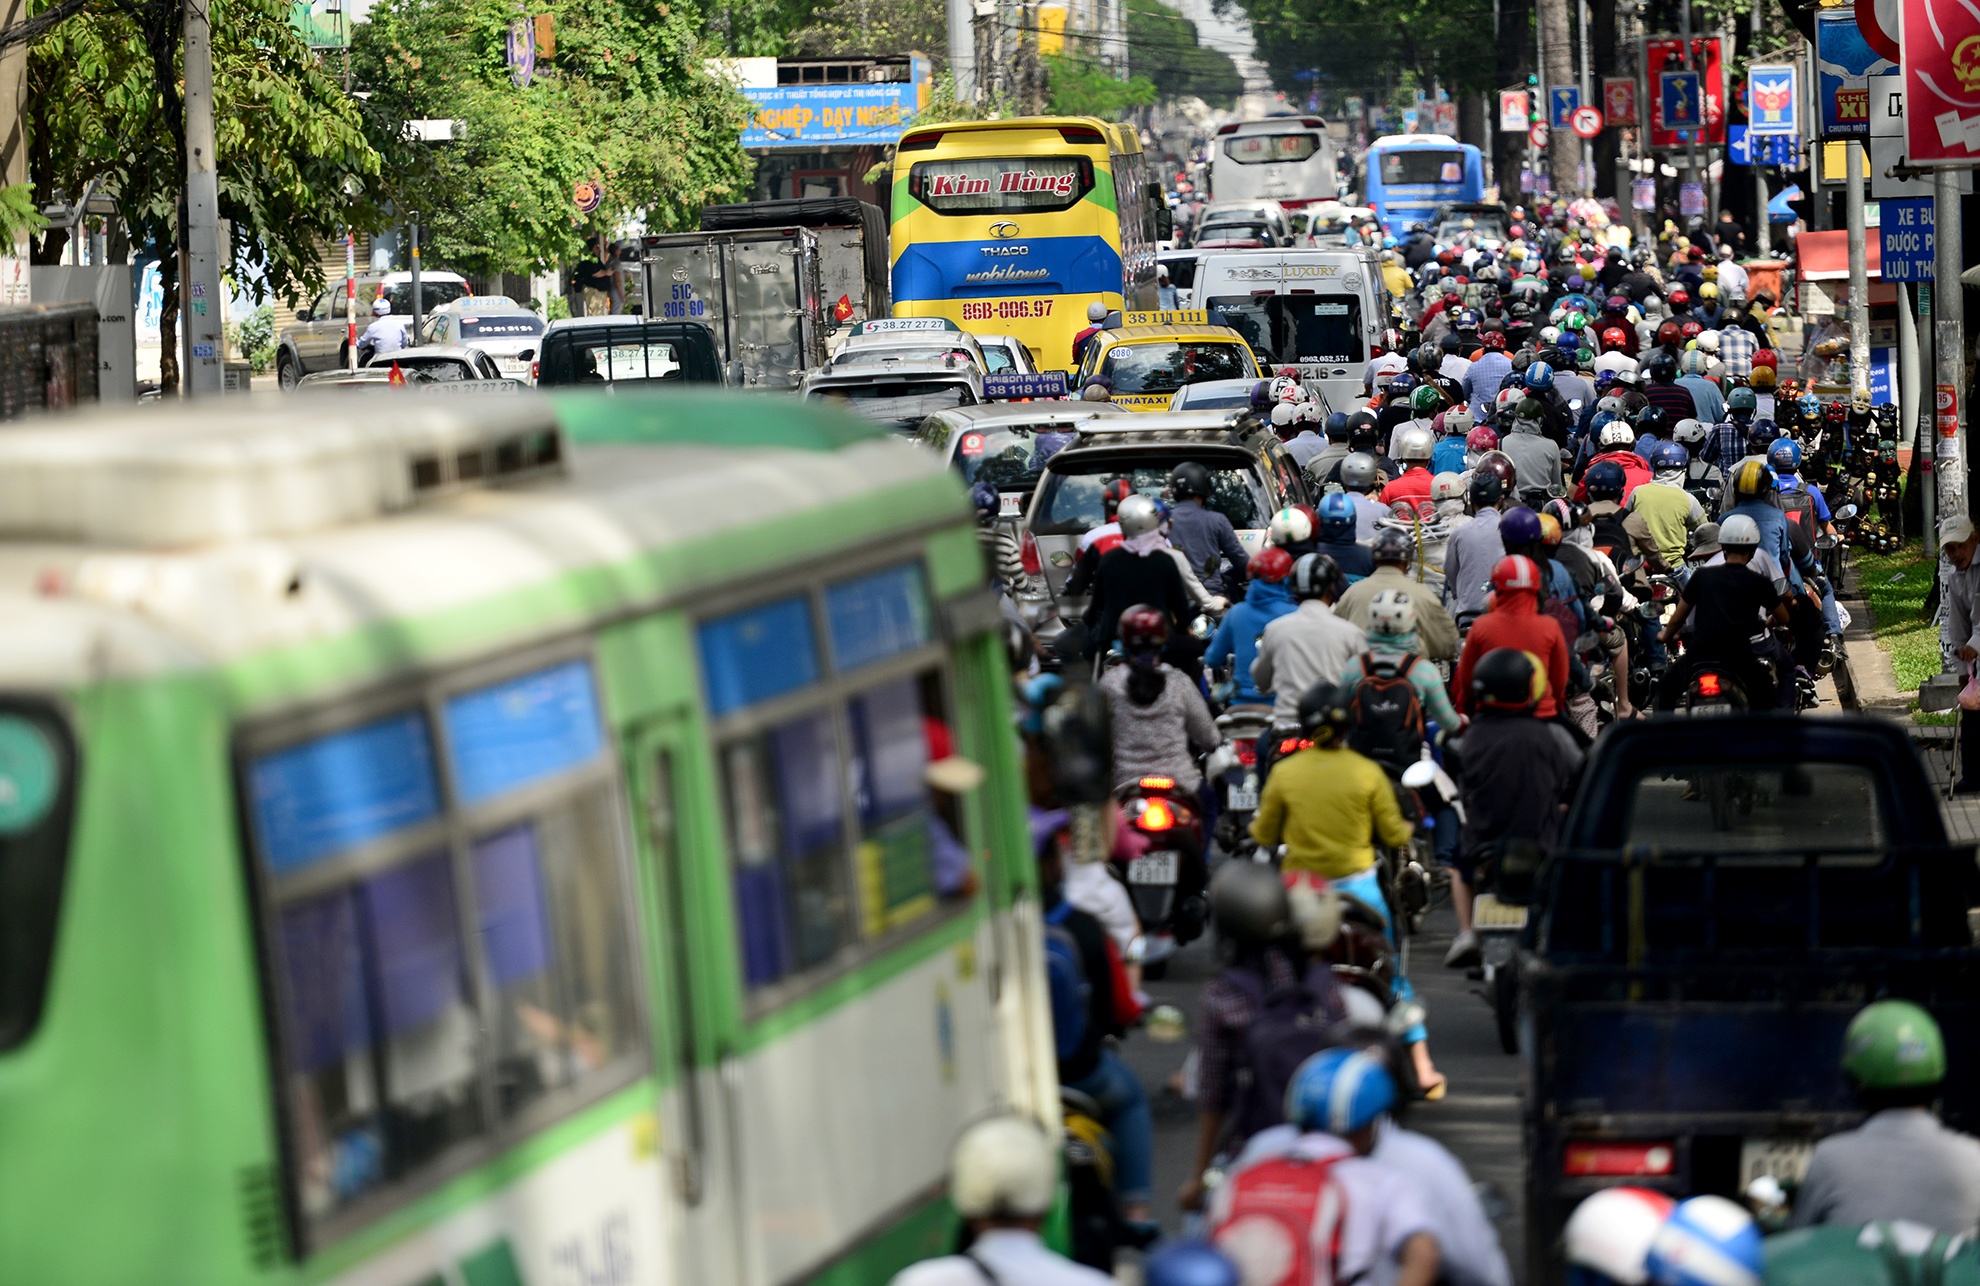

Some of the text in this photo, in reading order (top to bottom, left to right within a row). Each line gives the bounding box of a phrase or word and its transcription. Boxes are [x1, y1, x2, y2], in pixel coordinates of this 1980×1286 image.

[822, 106, 854, 134] DẠY
[1828, 124, 1851, 133] CHUNG
[929, 170, 1075, 197] Kim Hùng
[1898, 207, 1935, 226] XE BU
[1886, 230, 1920, 257] ĐƯỢC
[980, 246, 1029, 256] THACO
[965, 263, 1050, 283] mobihome
[1283, 266, 1338, 278] LUXURY
[1886, 257, 1910, 279] LƯU
[671, 283, 692, 301] 51C
[486, 298, 495, 306] 21
[663, 300, 704, 318] 306 60
[962, 300, 1054, 320] 86B-006.97
[931, 320, 943, 328] 27
[1128, 312, 1202, 324] 38 111 111
[657, 349, 669, 357] 27
[1111, 348, 1131, 358] 5080
[985, 375, 1023, 384] SAIGON
[1041, 373, 1062, 381] TAXI
[500, 381, 515, 392] 27
[988, 382, 1060, 395] 38 118 118
[1110, 396, 1168, 405] VINATAXI
